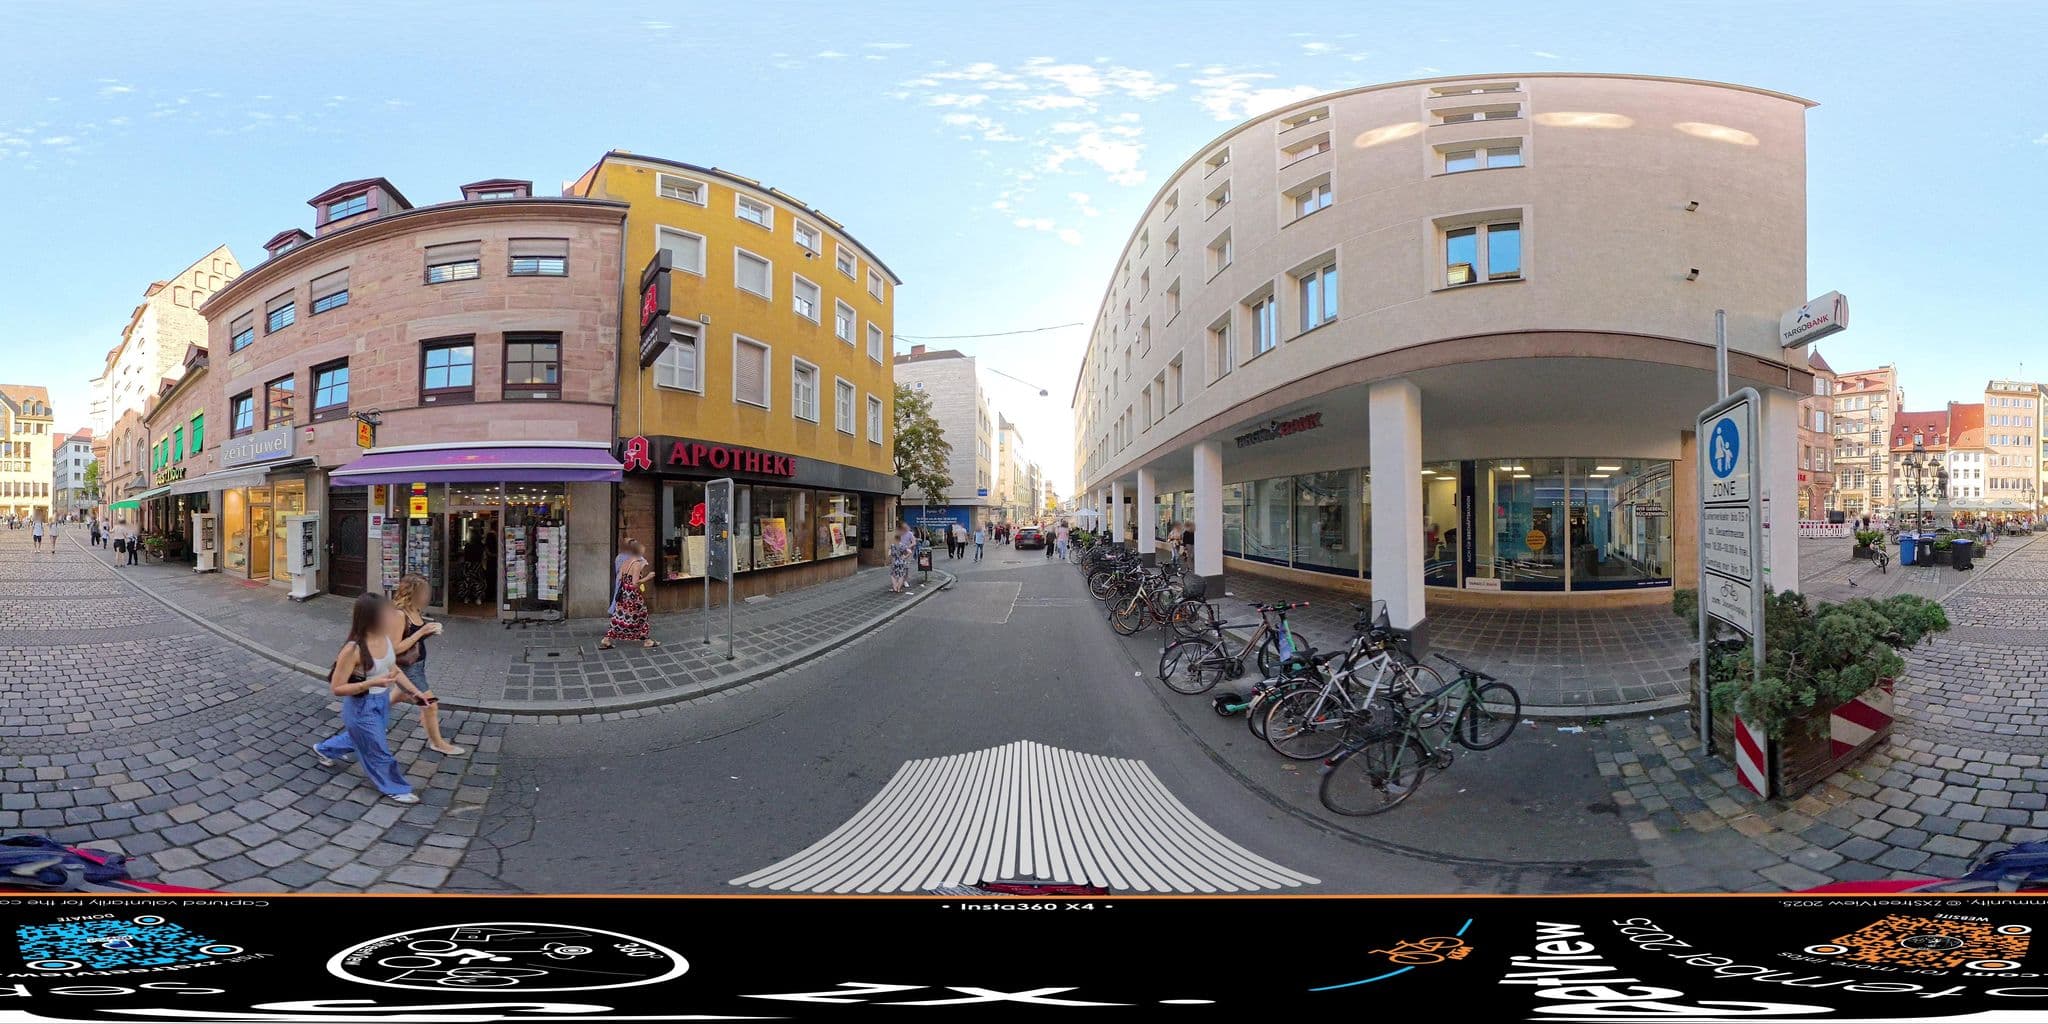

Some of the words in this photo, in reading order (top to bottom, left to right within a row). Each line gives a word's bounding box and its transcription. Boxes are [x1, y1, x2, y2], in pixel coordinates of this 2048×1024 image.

[1783, 313, 1829, 340] TARGOBANK
[667, 441, 798, 476] APOTHEKE
[1712, 480, 1736, 498] ZONE
